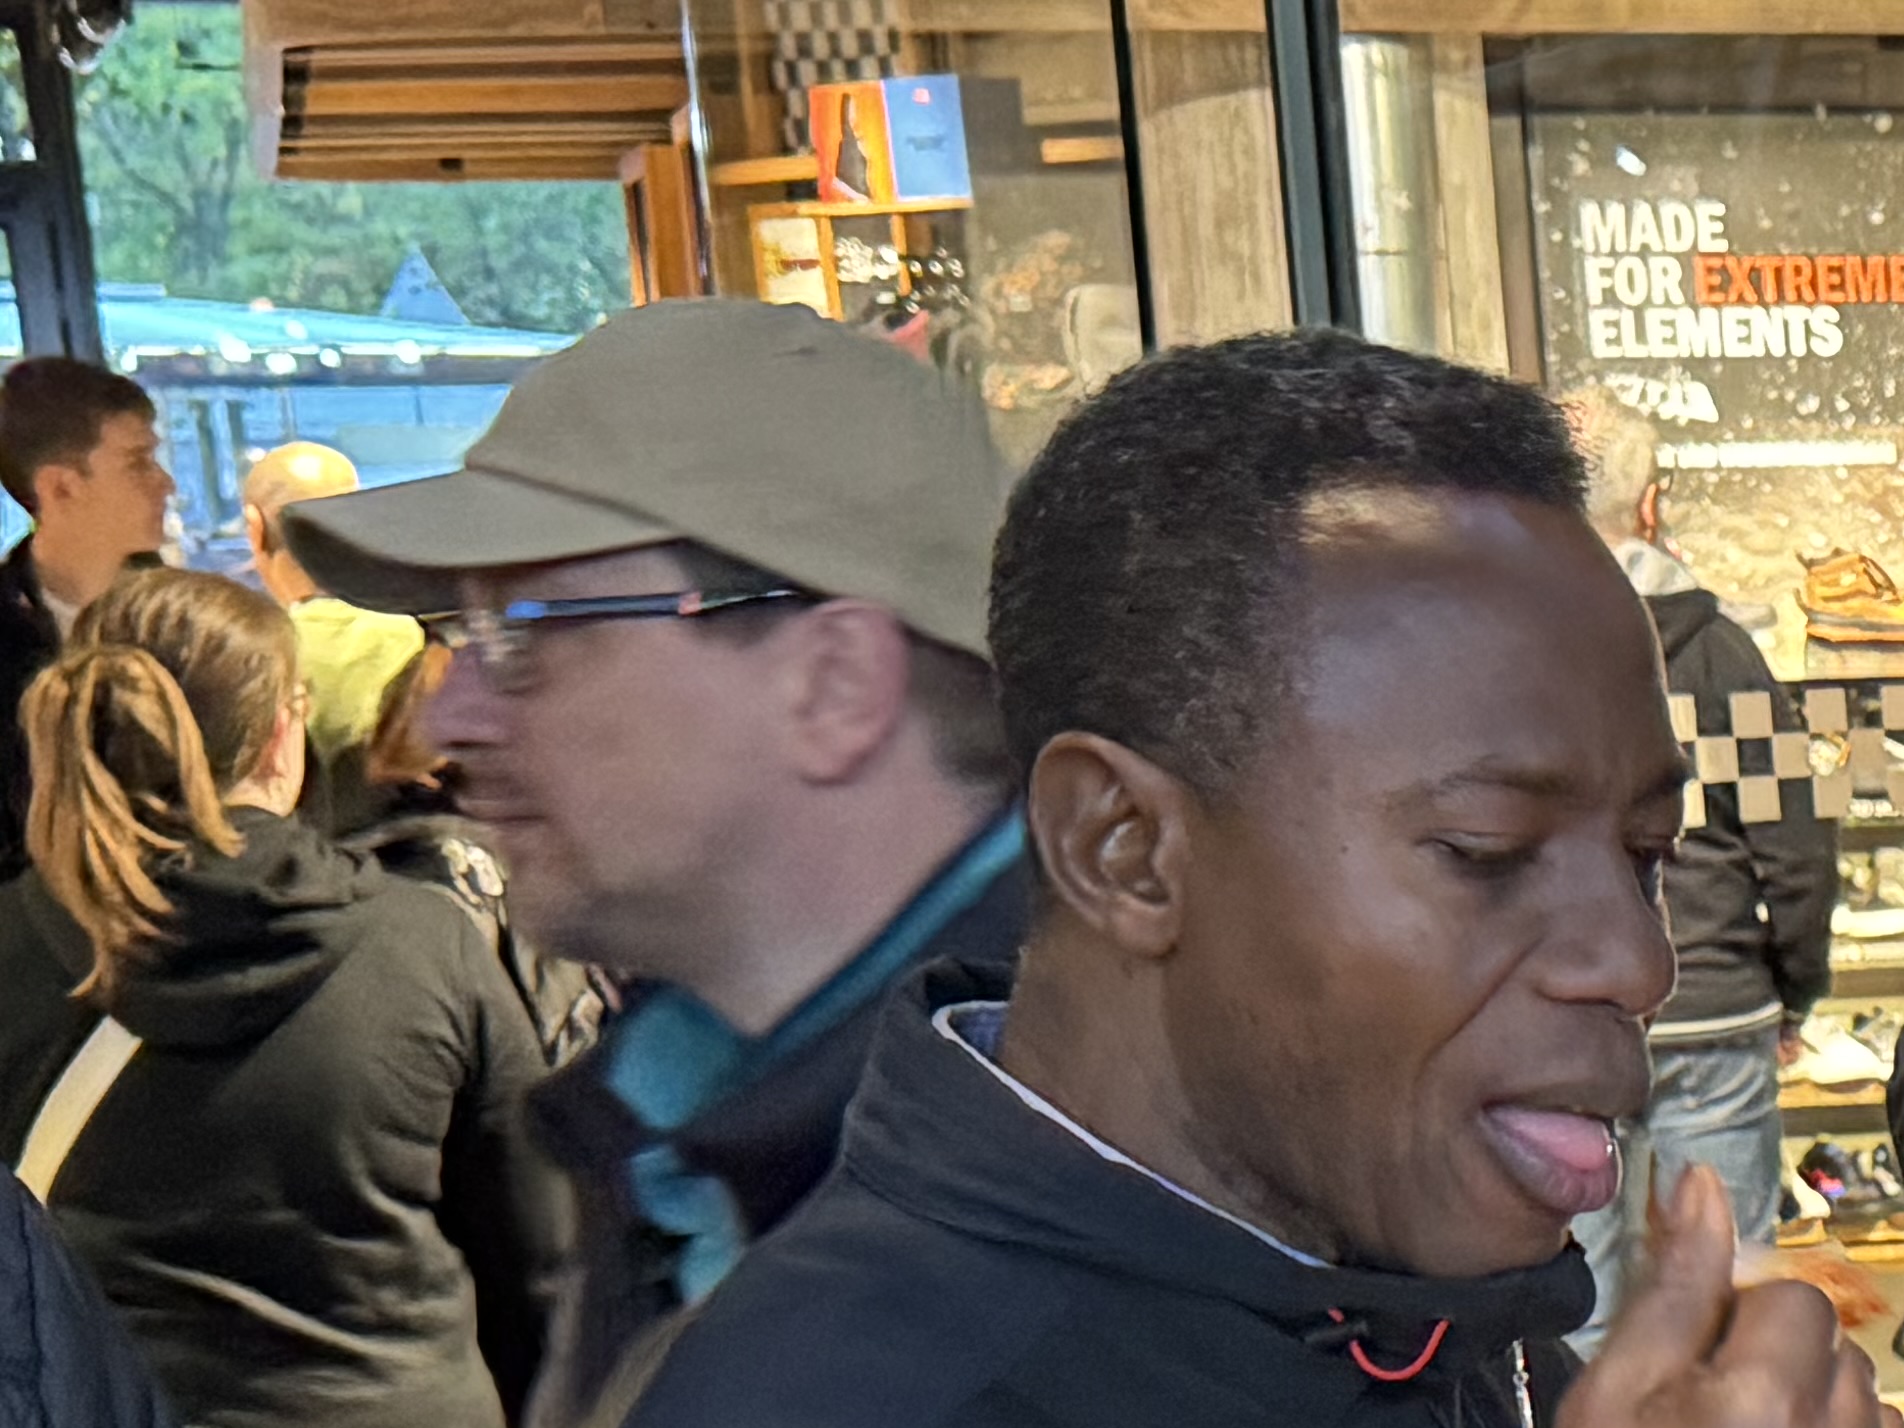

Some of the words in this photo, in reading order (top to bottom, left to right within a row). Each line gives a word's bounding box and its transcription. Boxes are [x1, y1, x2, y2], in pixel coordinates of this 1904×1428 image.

[1581, 202, 1728, 253] MADE
[1586, 257, 1683, 305] FOR
[1590, 306, 1844, 358] ELEMENTS
